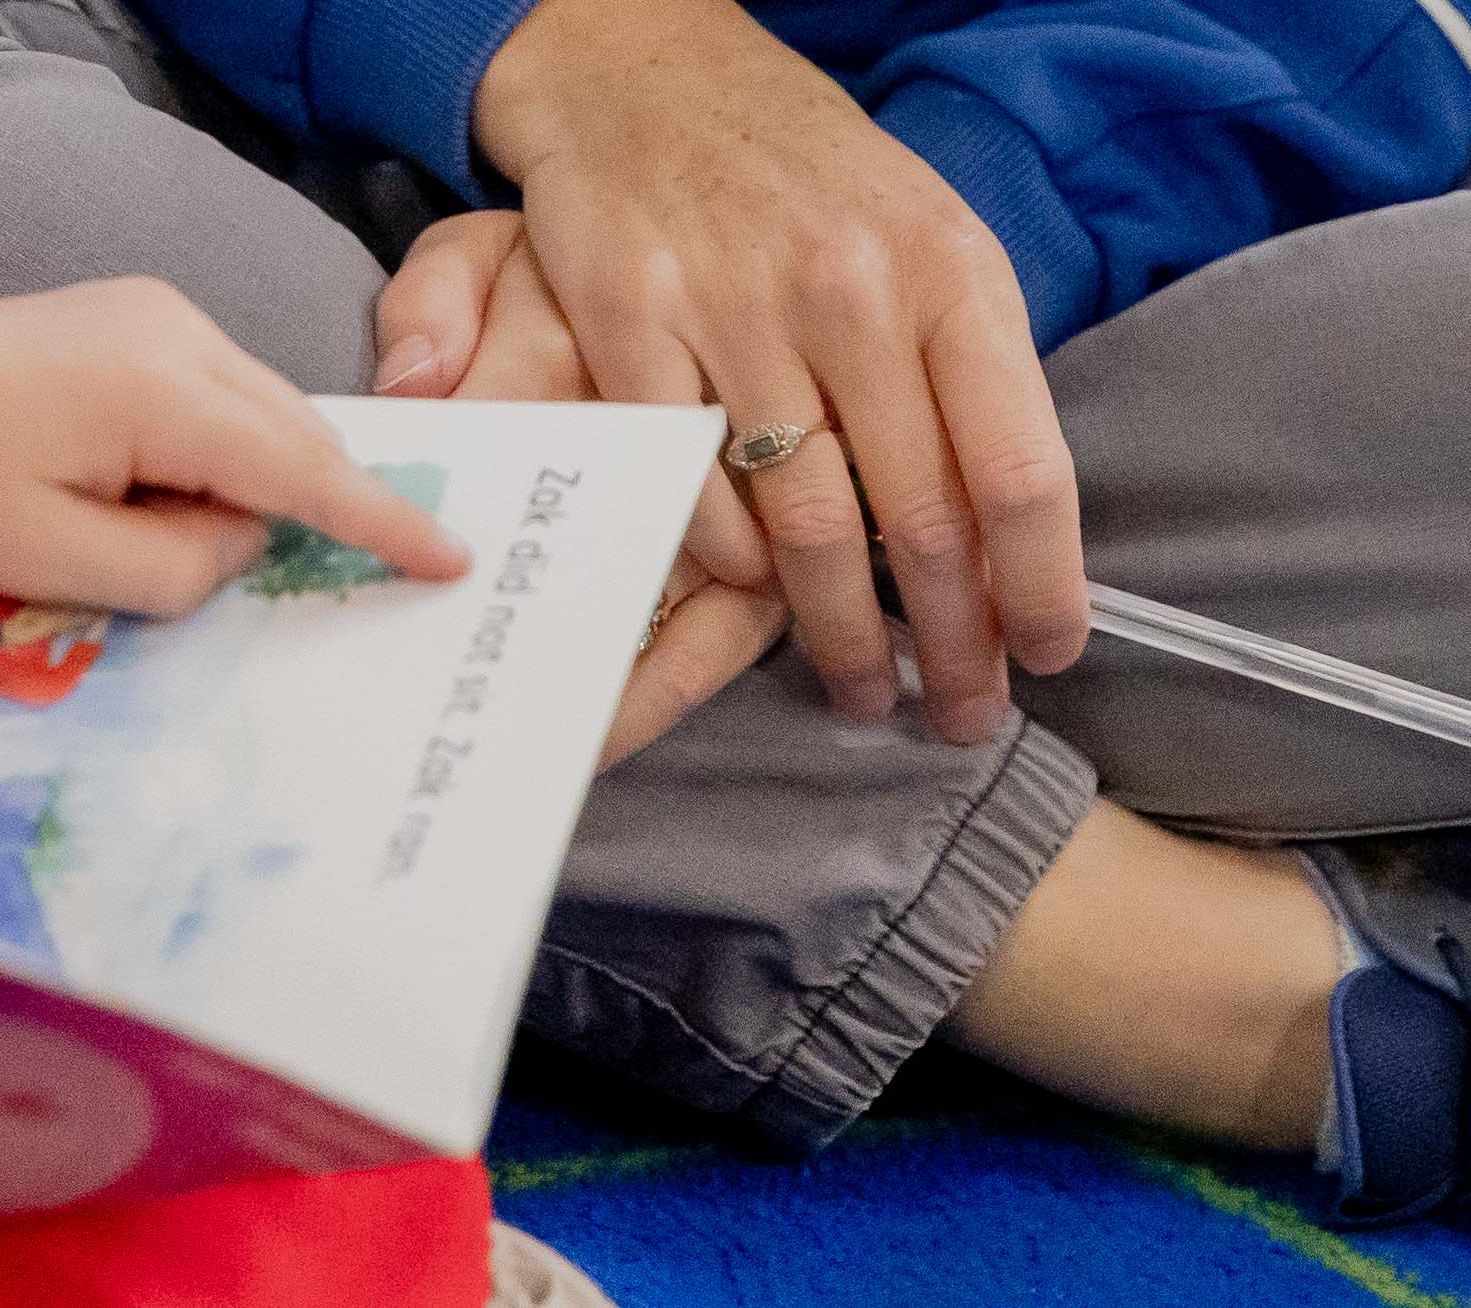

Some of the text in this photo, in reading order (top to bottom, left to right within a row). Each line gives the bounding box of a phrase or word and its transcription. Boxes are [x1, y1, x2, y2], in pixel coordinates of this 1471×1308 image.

[517, 465, 583, 529] Zak
[493, 537, 549, 596] did
[463, 603, 516, 664] not
[409, 734, 477, 801] Zak
